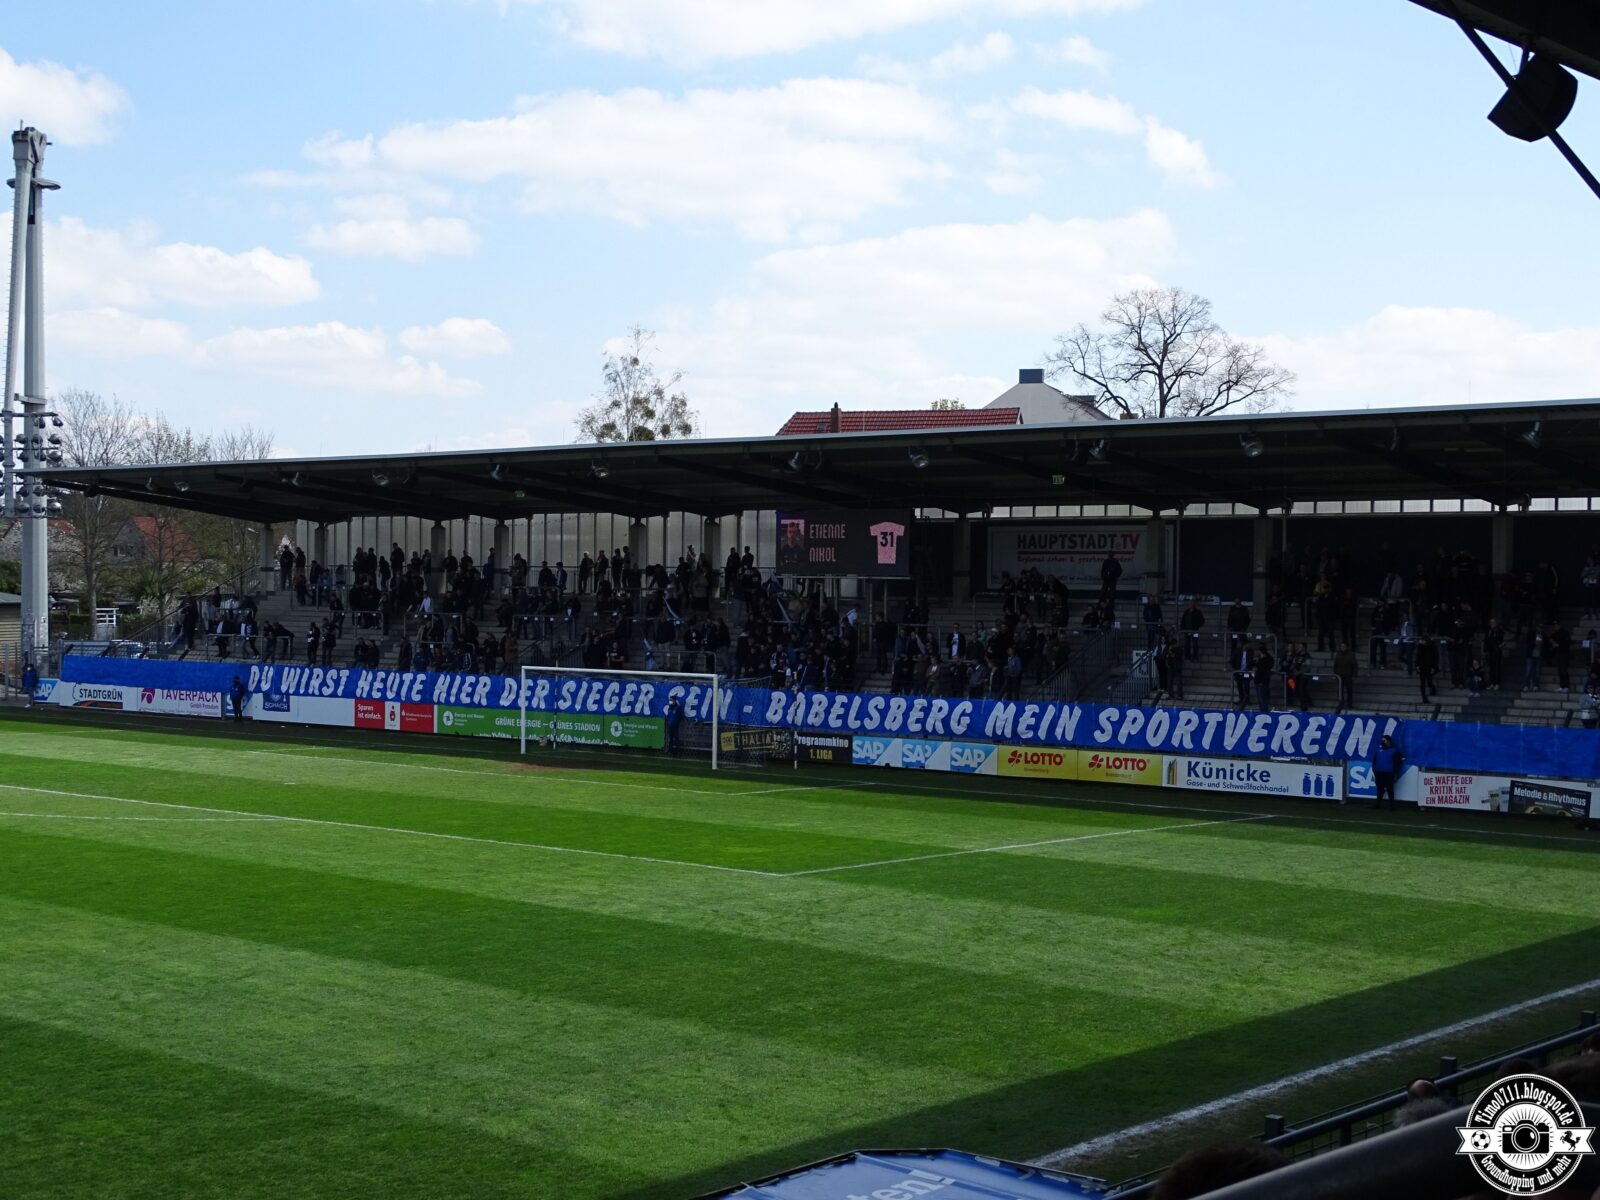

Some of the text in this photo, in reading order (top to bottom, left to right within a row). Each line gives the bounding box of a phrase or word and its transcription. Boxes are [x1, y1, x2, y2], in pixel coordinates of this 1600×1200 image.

[809, 523, 846, 539] ETIENNE
[880, 531, 895, 548] 31
[809, 547, 837, 562] NIKOL
[79, 688, 123, 701] STADTGRÜN
[160, 689, 219, 703] TAVERPACK
[248, 665, 274, 692] DU
[281, 666, 350, 697] WIRST
[355, 670, 427, 702] HEUTE
[433, 674, 491, 706] HIER
[499, 677, 550, 710] DER
[557, 680, 655, 716] SIEGER
[766, 691, 973, 736] BABELSBERG
[984, 701, 1082, 742] MEIN
[357, 704, 374, 712] Sparen
[357, 711, 365, 719] ist
[495, 716, 516, 727] GRÜNE
[549, 720, 573, 730] GÜNES
[574, 722, 601, 732] STADION
[735, 733, 772, 746] THALIA
[816, 749, 833, 760] LIGA
[852, 740, 884, 760] SAP
[951, 747, 985, 768] SAP
[1024, 752, 1063, 766] LOTTO
[1105, 756, 1147, 772] LOTTO
[1187, 760, 1271, 783] Künicke
[1186, 779, 1206, 787] Gase-
[1222, 781, 1289, 793] Schweißfachhandel
[1424, 777, 1434, 785] DIE
[1435, 776, 1459, 785] WAFFE
[1430, 785, 1467, 795] KRITIK HAT
[1513, 786, 1542, 799] Melodie
[1548, 792, 1586, 807] Rhythmus
[1426, 795, 1470, 805] EIN MAGAZIN
